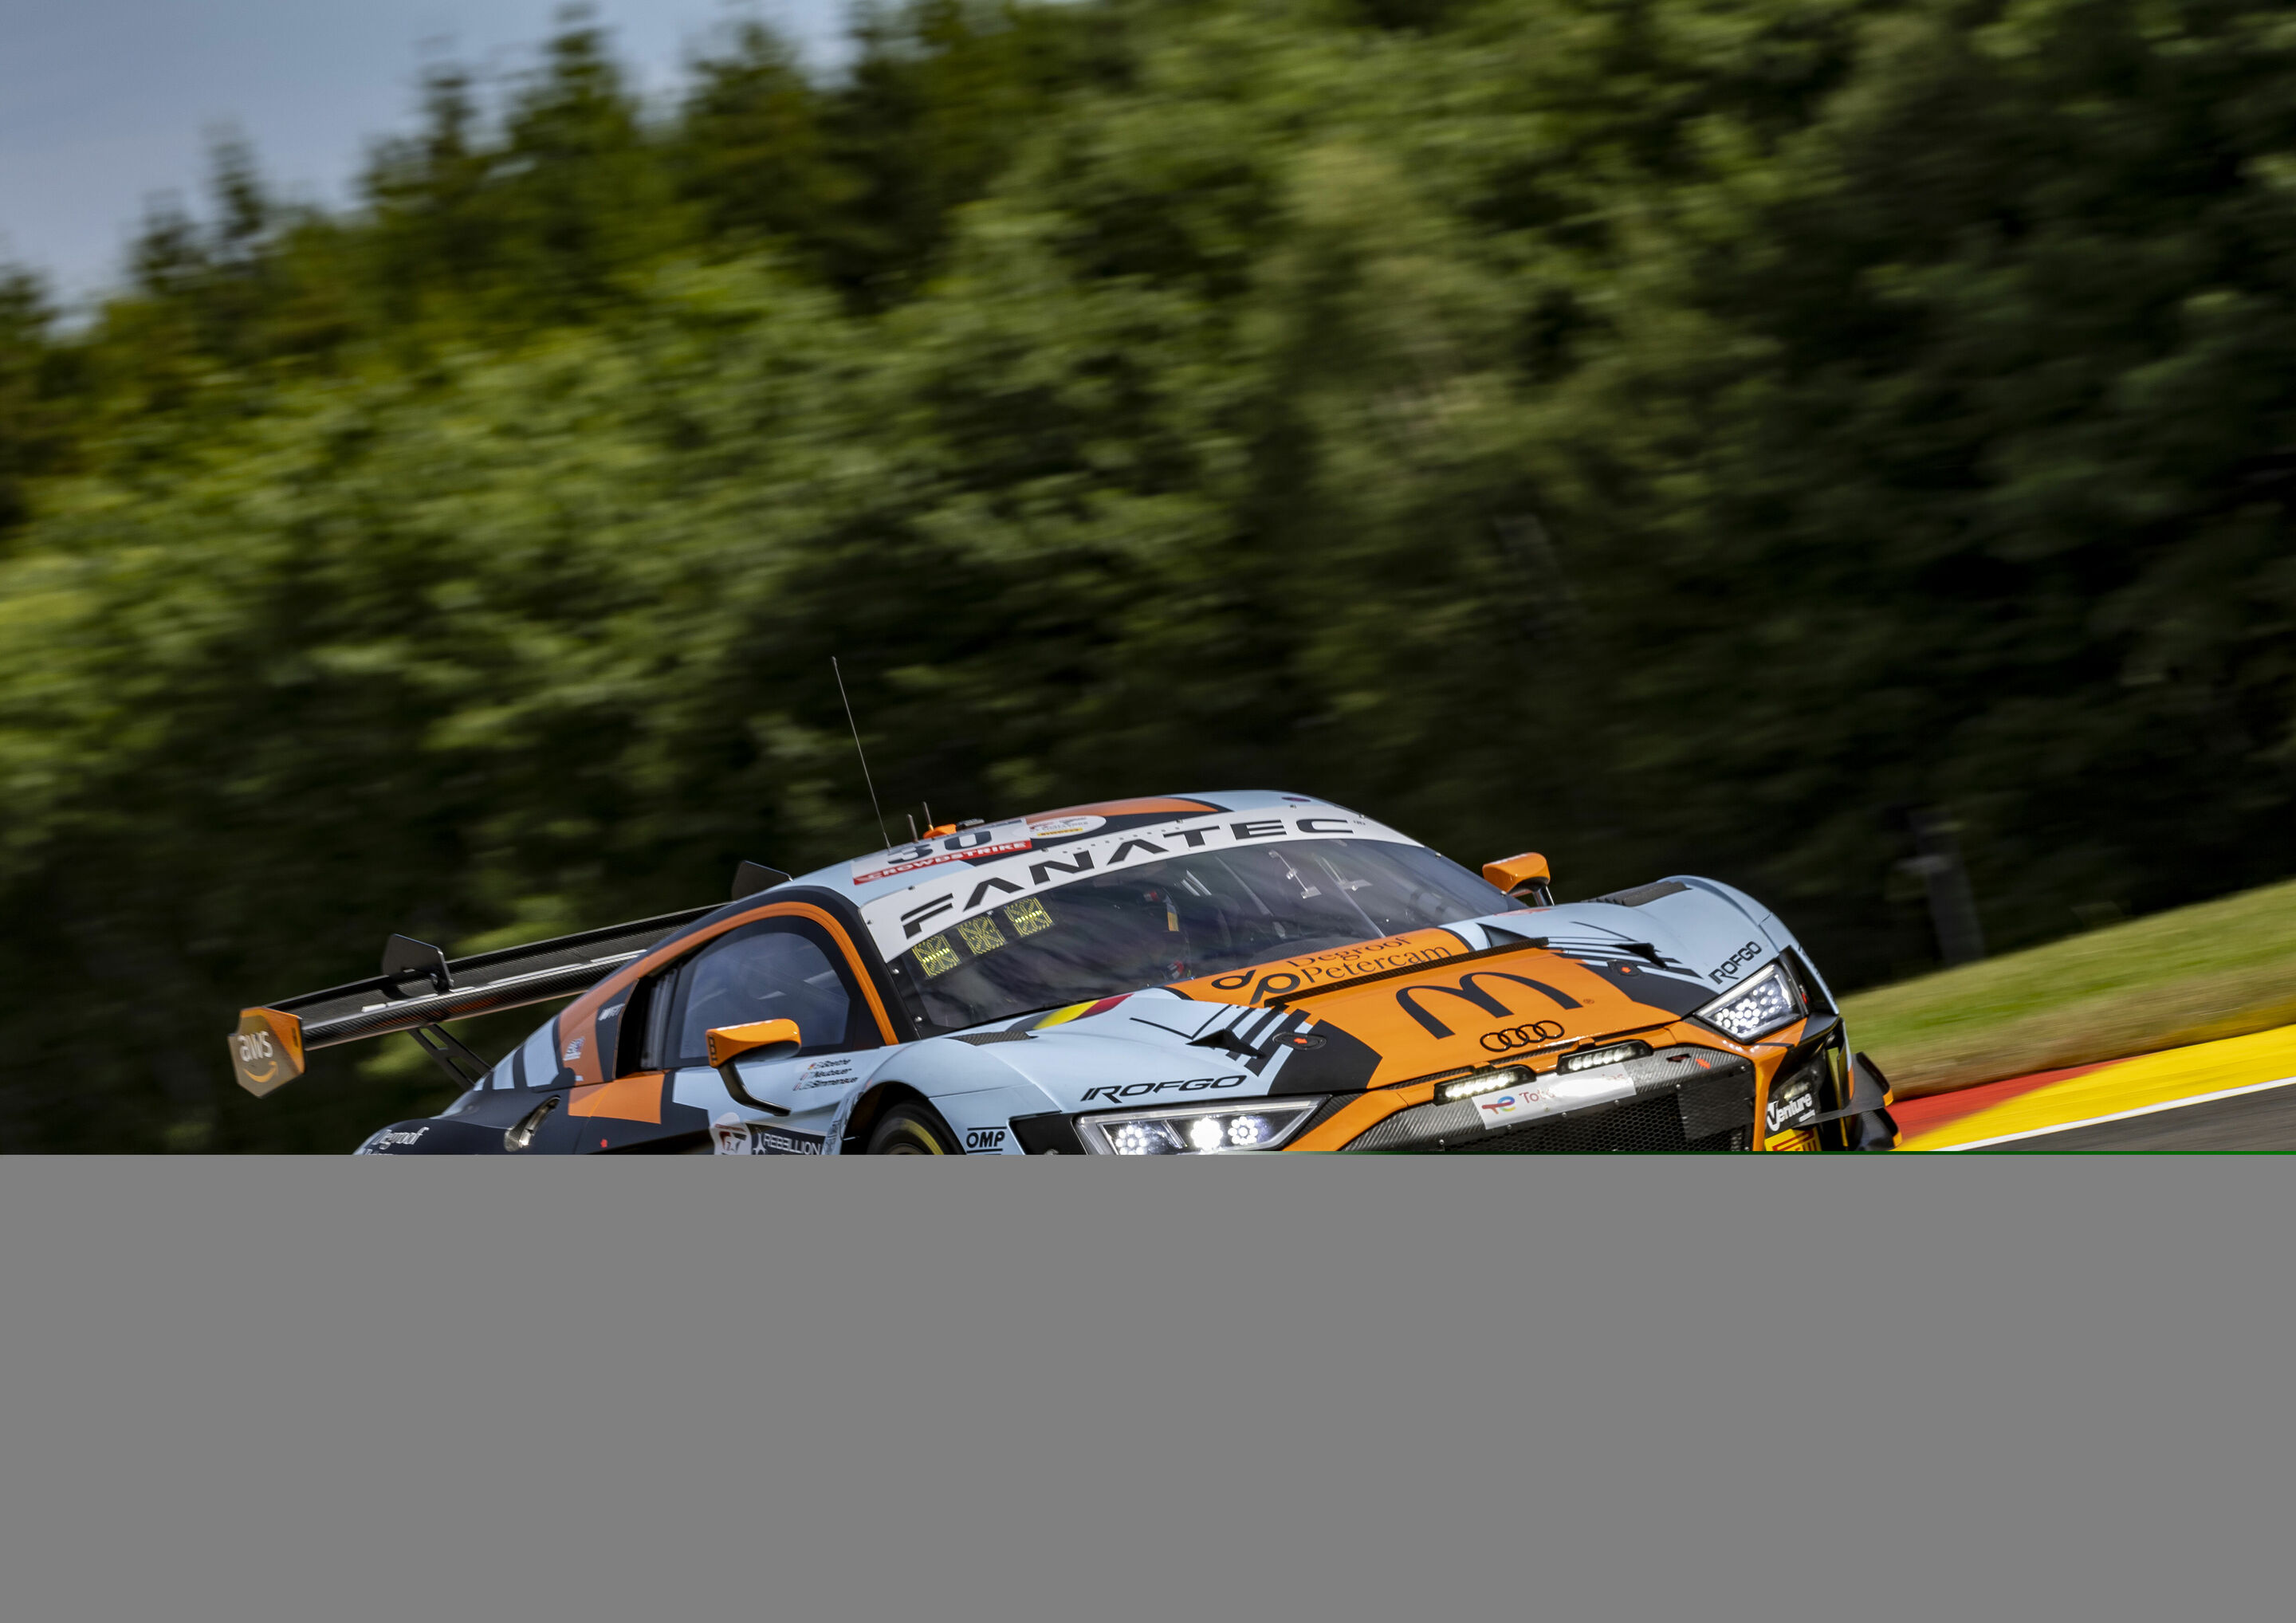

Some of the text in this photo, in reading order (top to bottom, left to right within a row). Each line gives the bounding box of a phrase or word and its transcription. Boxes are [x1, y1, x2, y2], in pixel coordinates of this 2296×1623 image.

[867, 840, 1027, 879] CROWDSTRIKE
[887, 831, 993, 865] 30
[901, 819, 1354, 940] FANATEC
[1286, 936, 1411, 967] Degroof
[1301, 945, 1453, 983] Petercam
[238, 1031, 273, 1062] aws
[1767, 1093, 1813, 1131] Venture
[763, 1133, 822, 1155] REBELLION
[966, 1130, 1005, 1148] OMP
